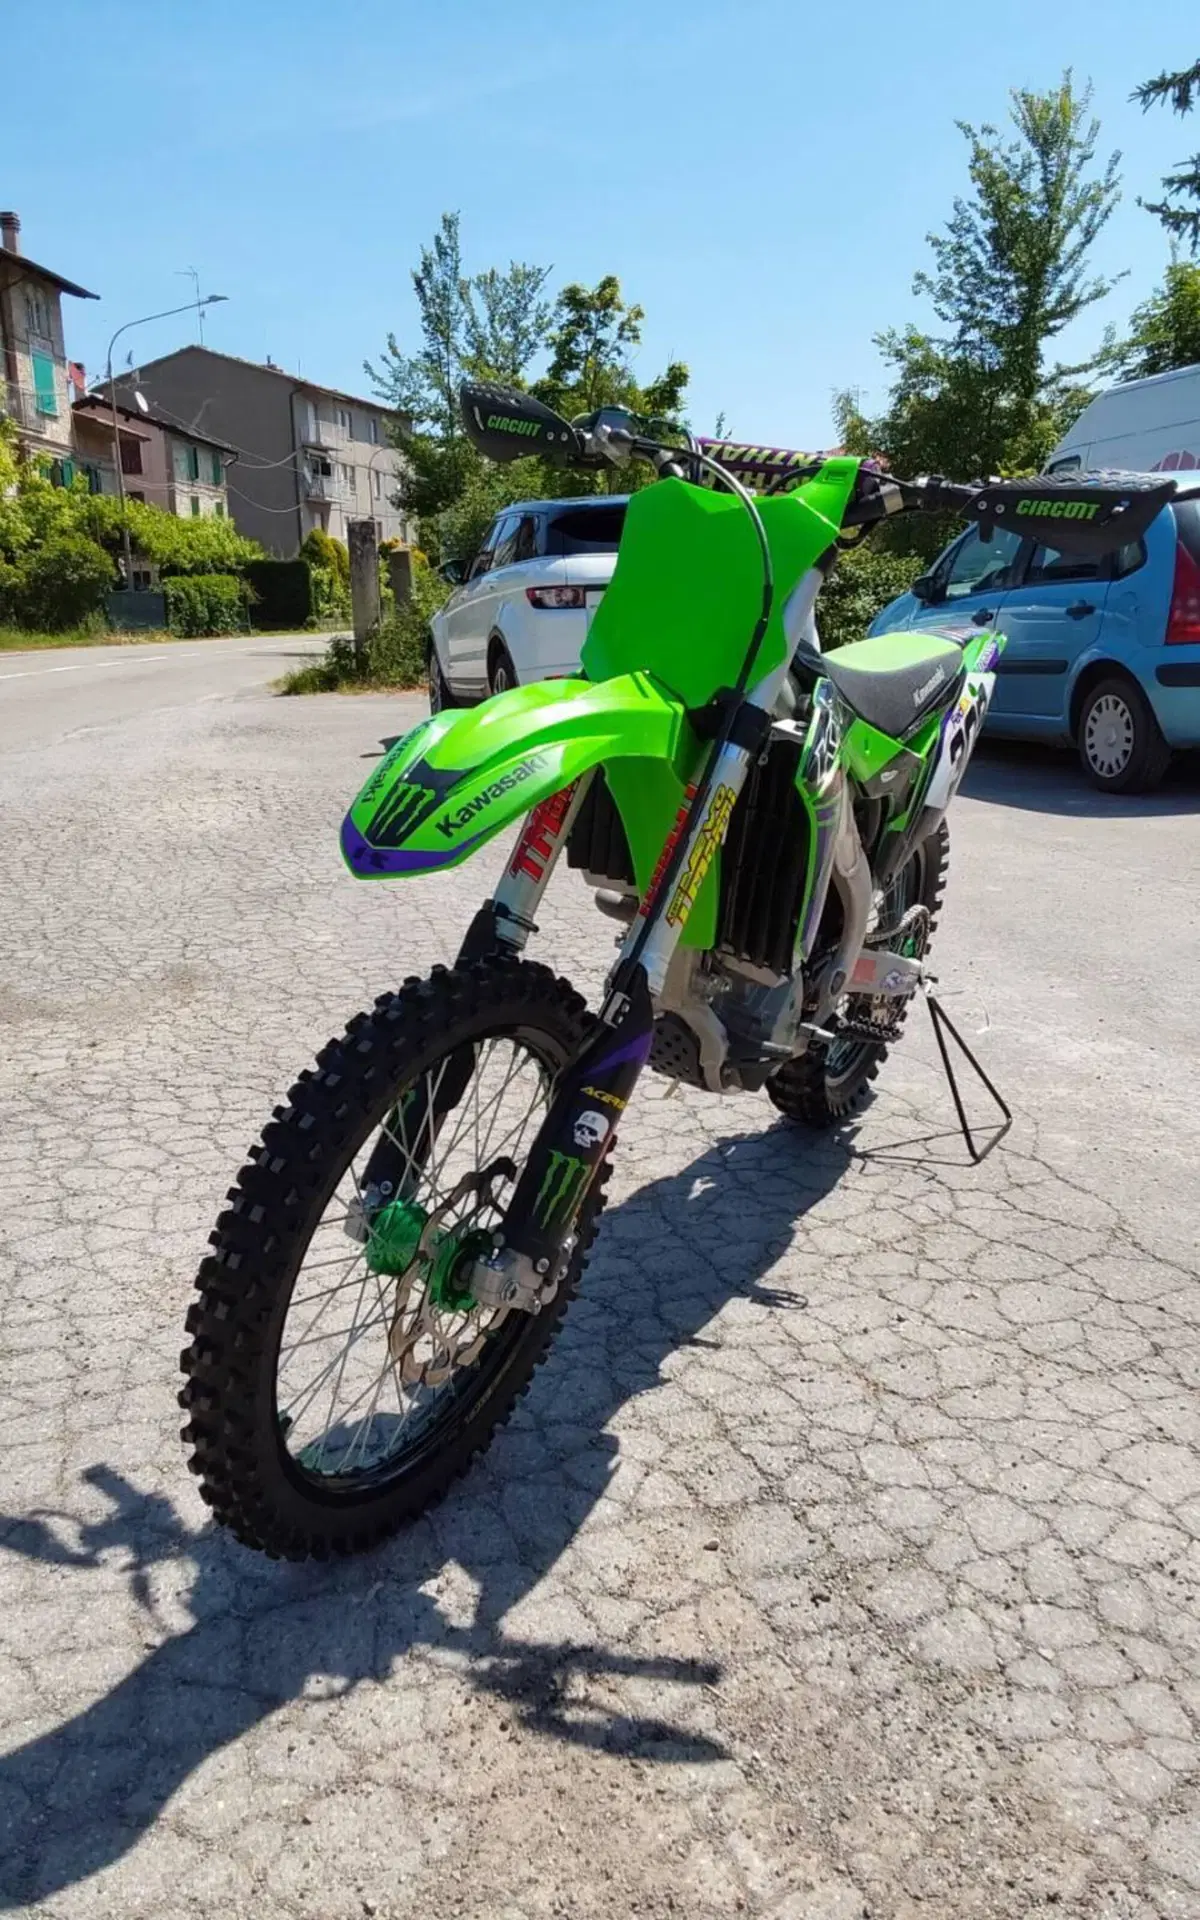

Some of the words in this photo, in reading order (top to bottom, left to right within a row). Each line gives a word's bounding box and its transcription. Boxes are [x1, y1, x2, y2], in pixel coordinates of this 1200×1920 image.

[486, 415, 542, 438] CIRCUIT
[704, 443, 820, 467] NTHAL
[1015, 499, 1100, 520] CIRCUIT
[435, 754, 549, 838] Kawasaki
